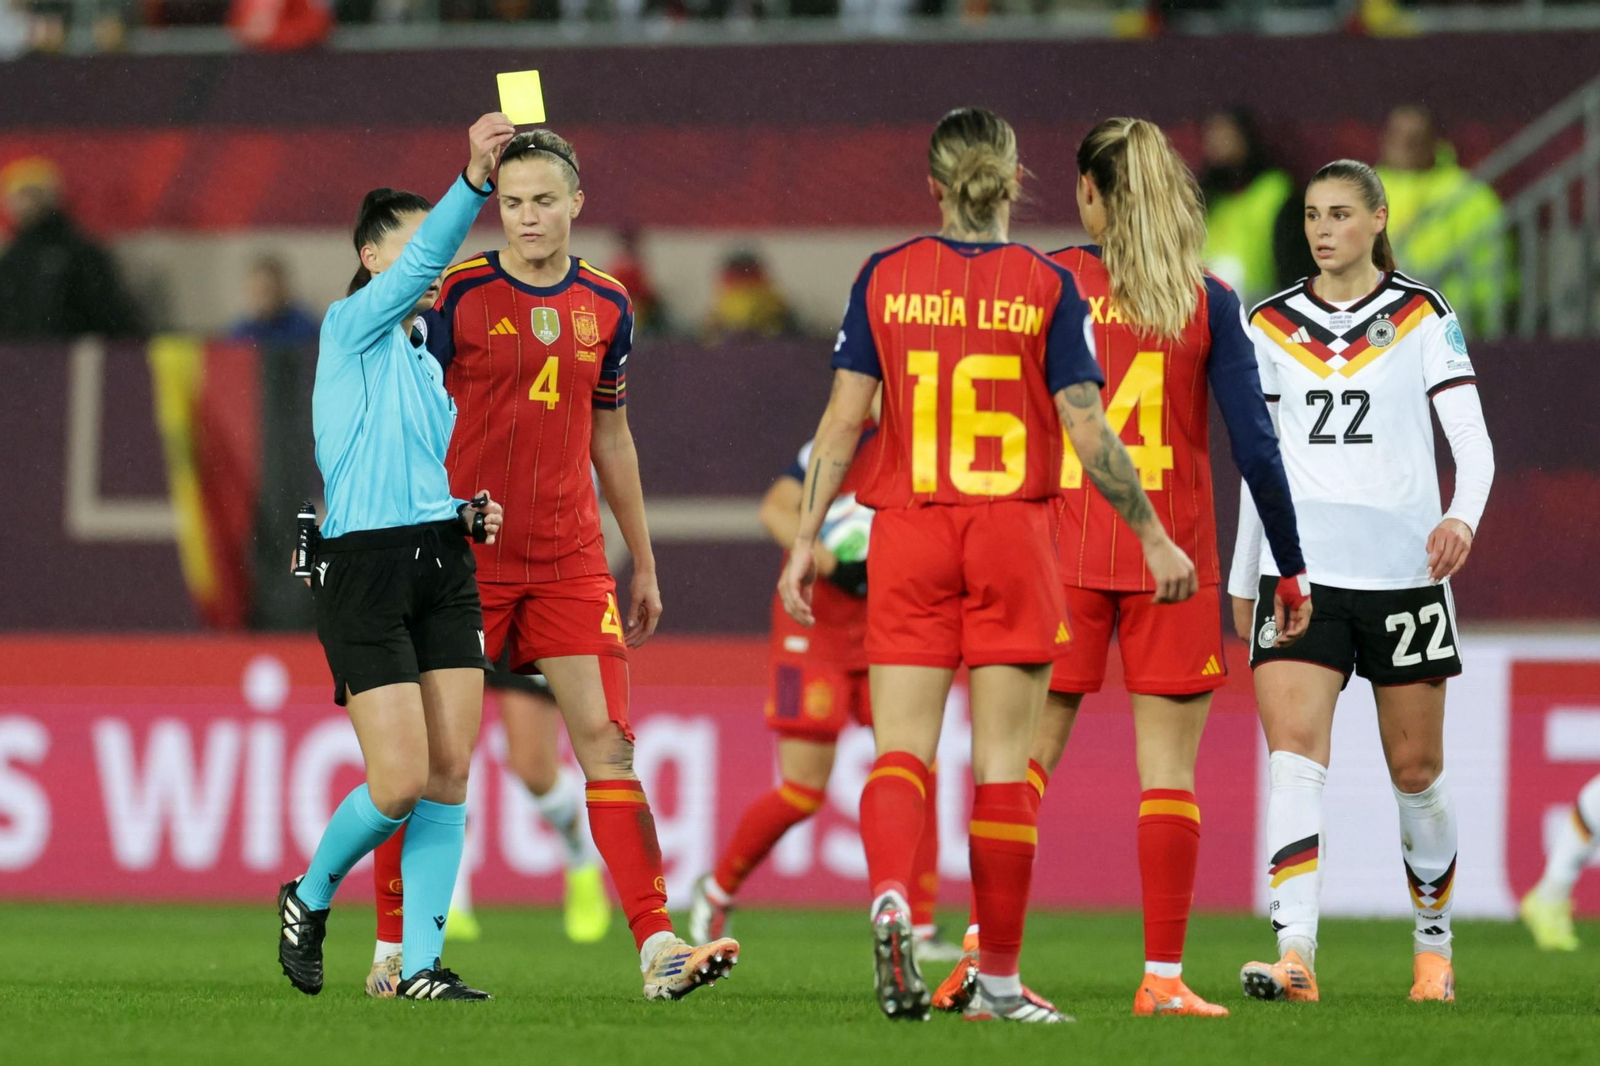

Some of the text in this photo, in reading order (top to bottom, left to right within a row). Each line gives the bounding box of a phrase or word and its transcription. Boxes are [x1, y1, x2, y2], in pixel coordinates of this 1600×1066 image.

[884, 289, 1044, 337] MARÍA LEÓN
[529, 356, 560, 410] 4
[907, 350, 1027, 496] 16
[1305, 390, 1373, 444] 22
[601, 592, 622, 643] 4
[1385, 602, 1455, 667] 22
